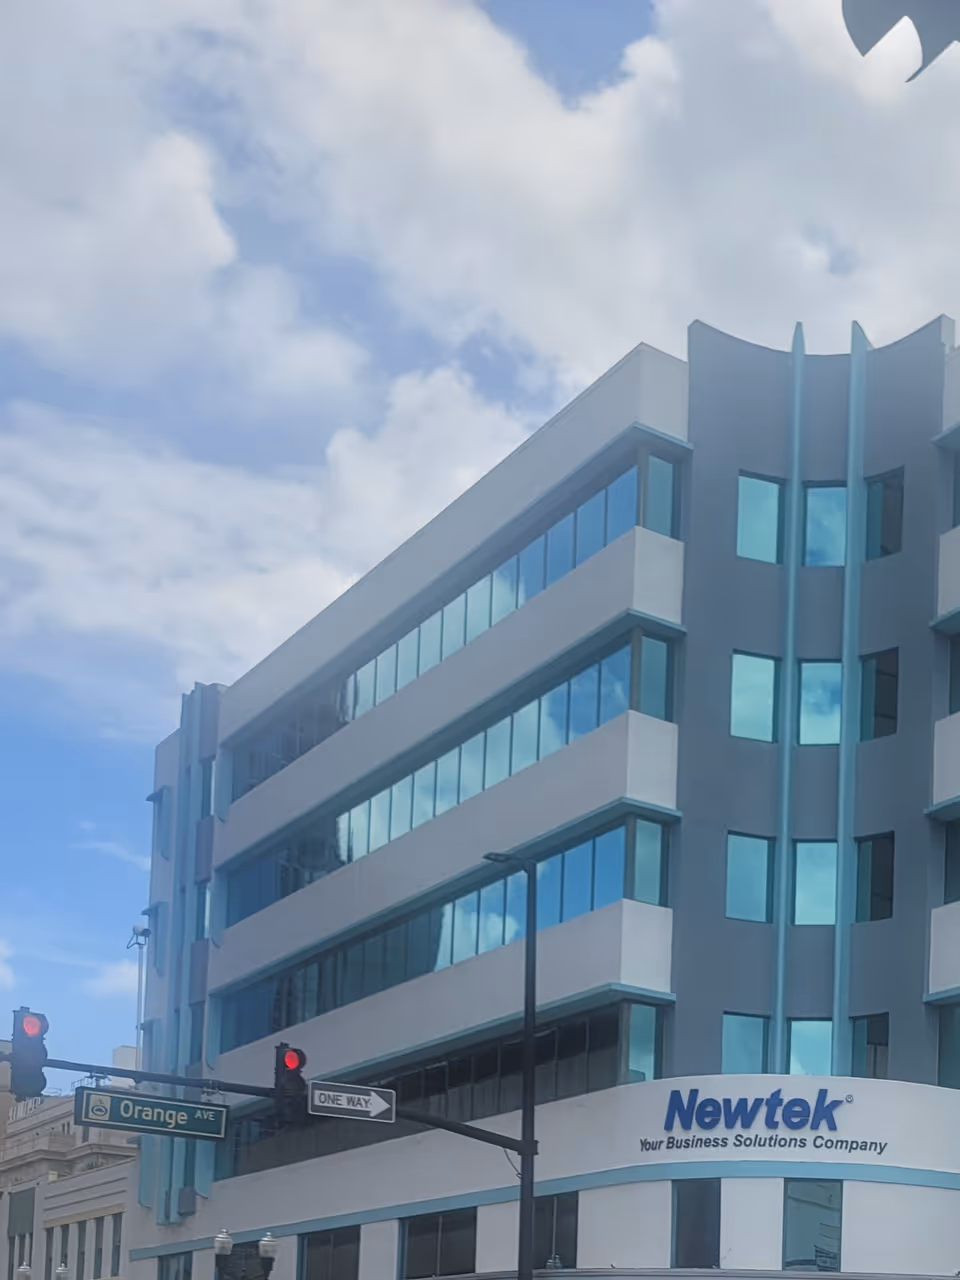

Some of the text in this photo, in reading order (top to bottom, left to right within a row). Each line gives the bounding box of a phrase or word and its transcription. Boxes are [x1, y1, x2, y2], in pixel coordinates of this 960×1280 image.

[318, 1093, 371, 1108] ONE WAY
[120, 1100, 216, 1128] Orange AVE
[640, 1134, 888, 1155] Your Business Solutions Company
